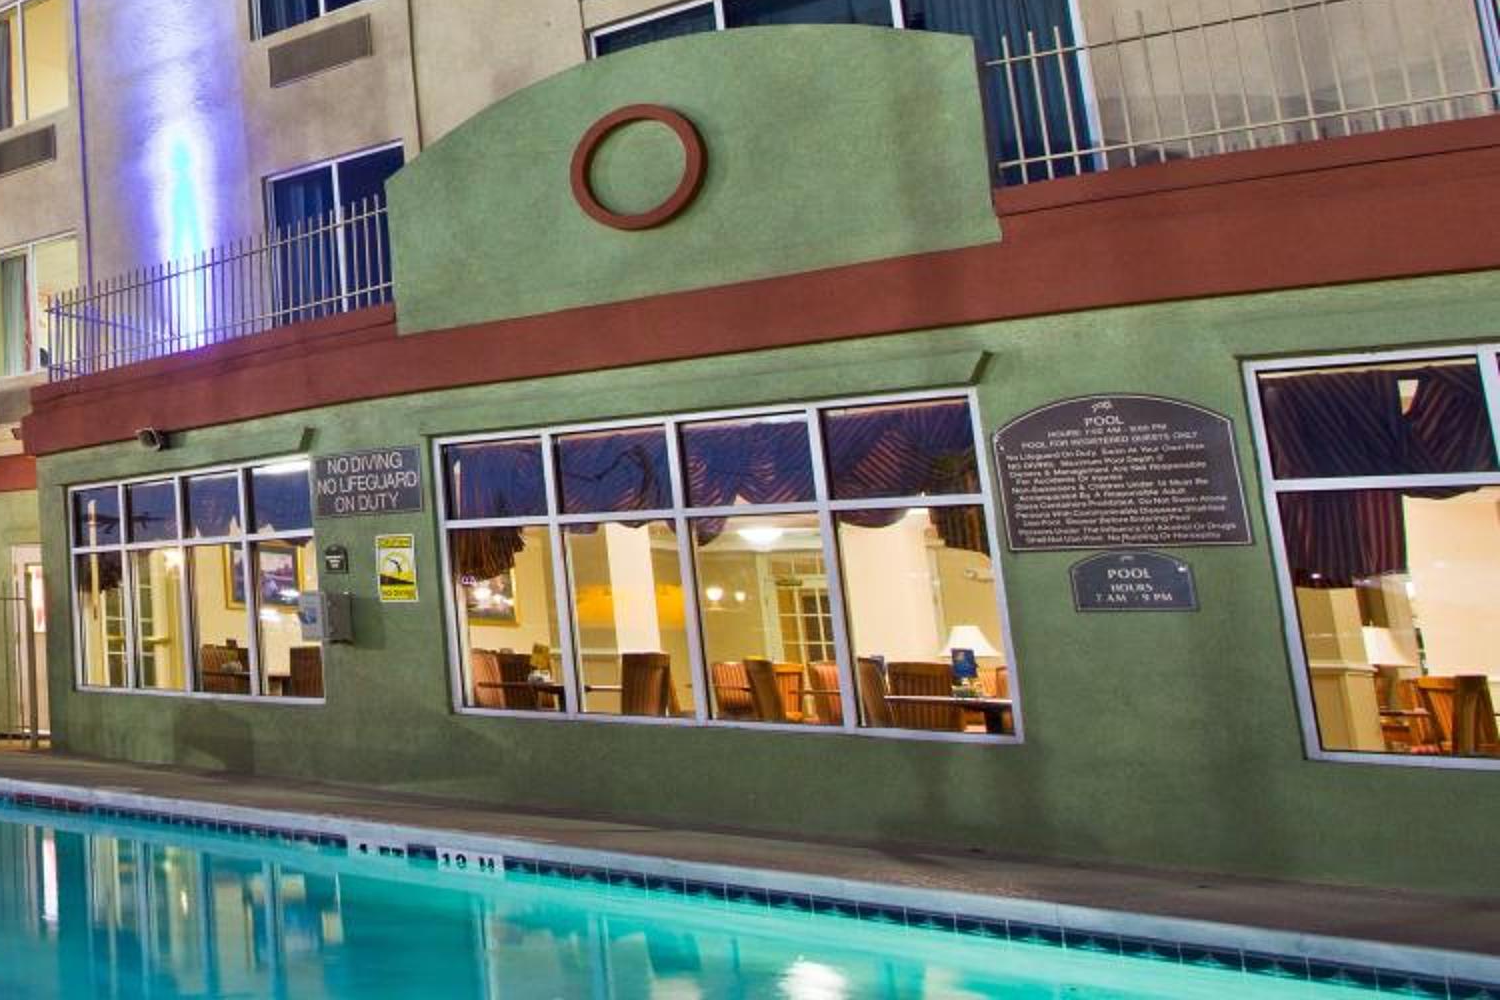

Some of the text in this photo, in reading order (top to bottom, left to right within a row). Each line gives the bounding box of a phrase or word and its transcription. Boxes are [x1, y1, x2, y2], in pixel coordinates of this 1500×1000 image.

[1084, 415, 1125, 427] POOL
[327, 452, 403, 474] NO DIVING
[317, 472, 418, 495] NO LIFEGUARD
[334, 492, 401, 512] ON DUTY
[1107, 567, 1152, 580] POOL
[1111, 582, 1153, 594] HOURS
[1106, 593, 1128, 602] AM
[1153, 591, 1173, 602] PM
